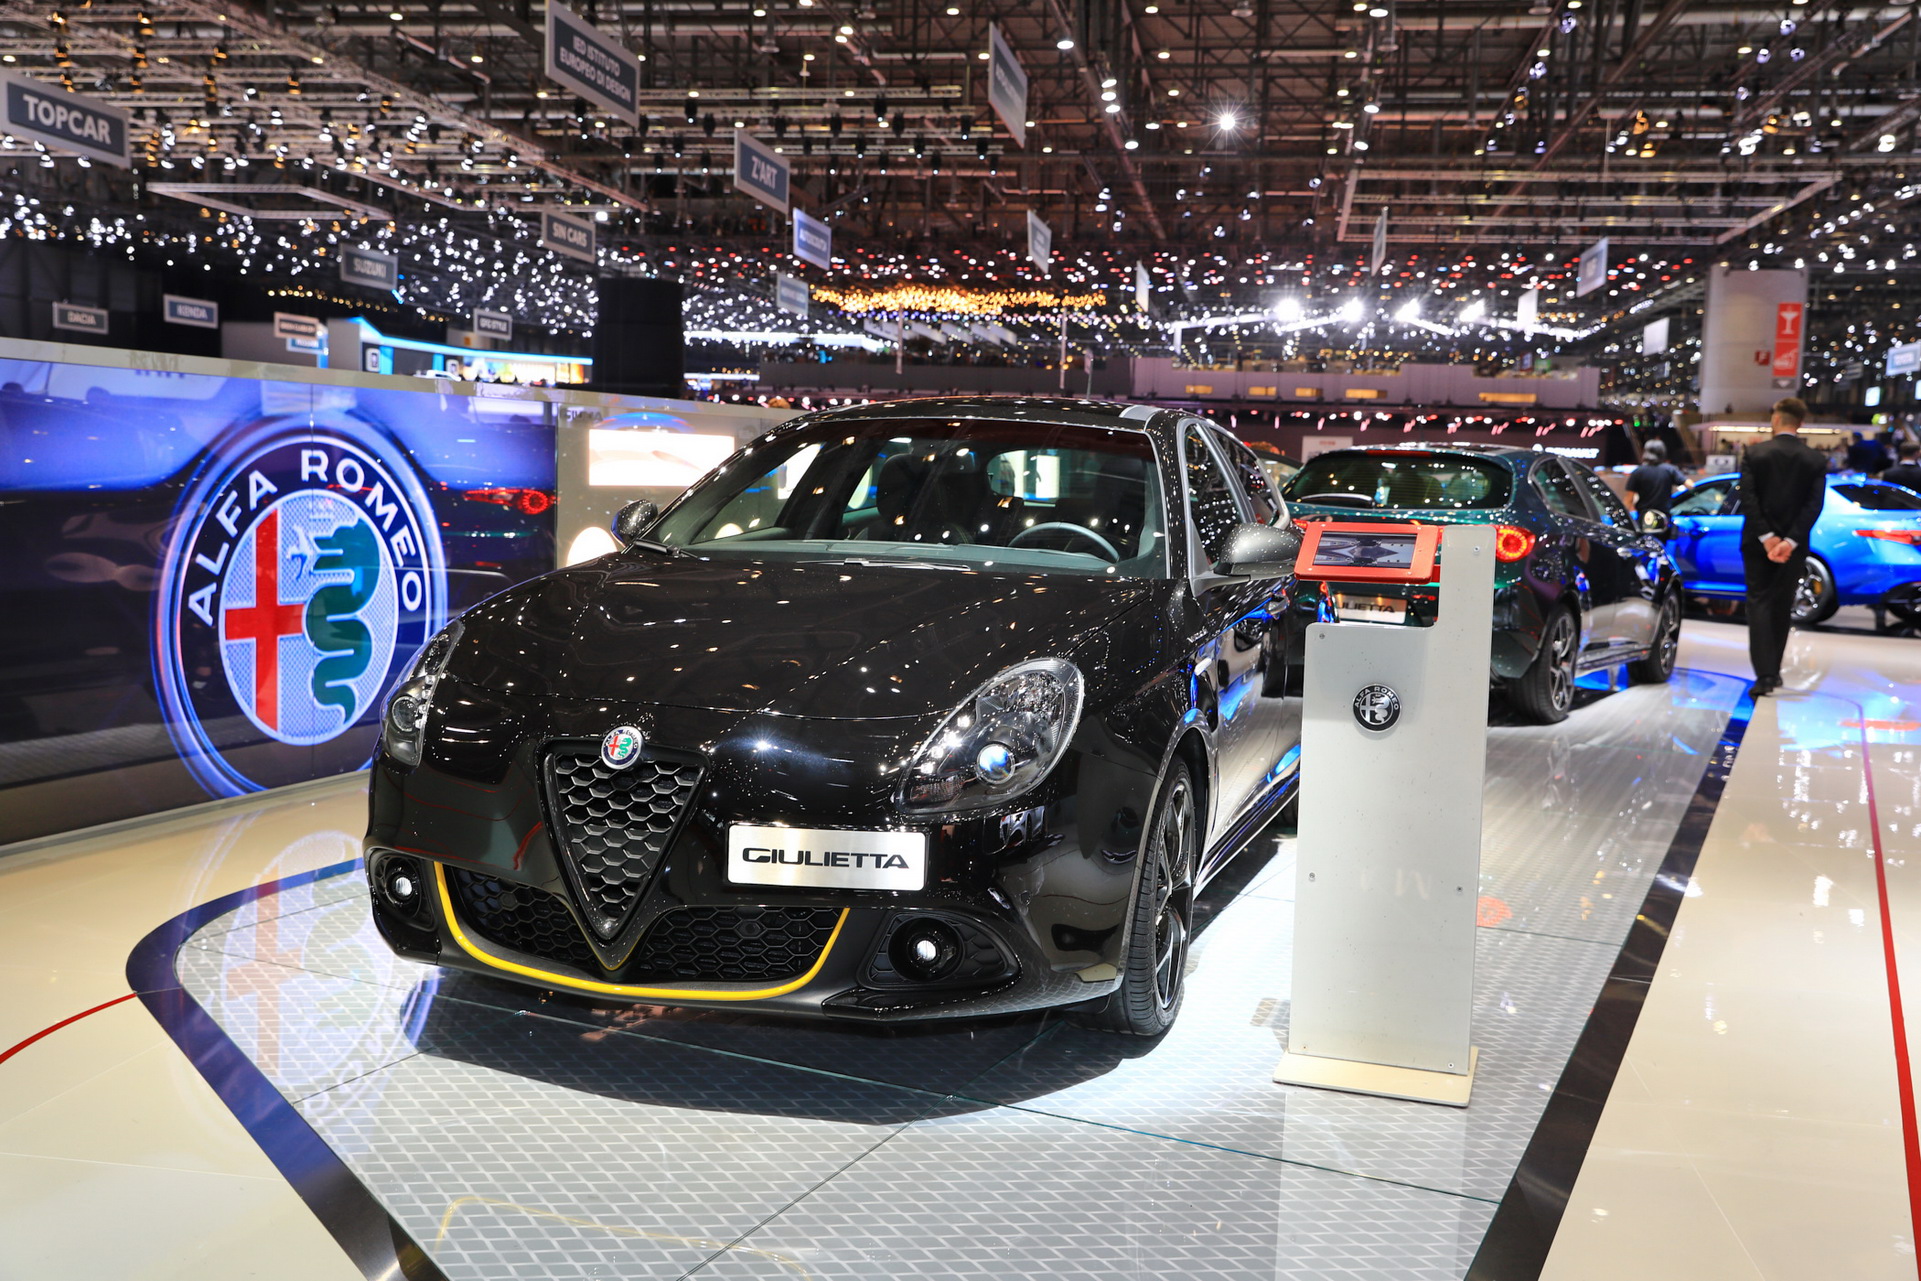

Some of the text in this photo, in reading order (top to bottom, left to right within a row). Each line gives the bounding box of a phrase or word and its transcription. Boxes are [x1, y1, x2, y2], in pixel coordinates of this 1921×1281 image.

[573, 35, 587, 56] IED
[560, 46, 632, 103] EUROPEO DI DESIGN
[22, 93, 112, 145] TOPCAR
[567, 227, 588, 248] CARS
[67, 310, 97, 326] DACIA
[176, 303, 209, 320] KENDA
[188, 449, 423, 627] ALFA ROMEO
[1354, 686, 1400, 710] ALFA ROMEO
[742, 847, 910, 869] GIULIETTA
